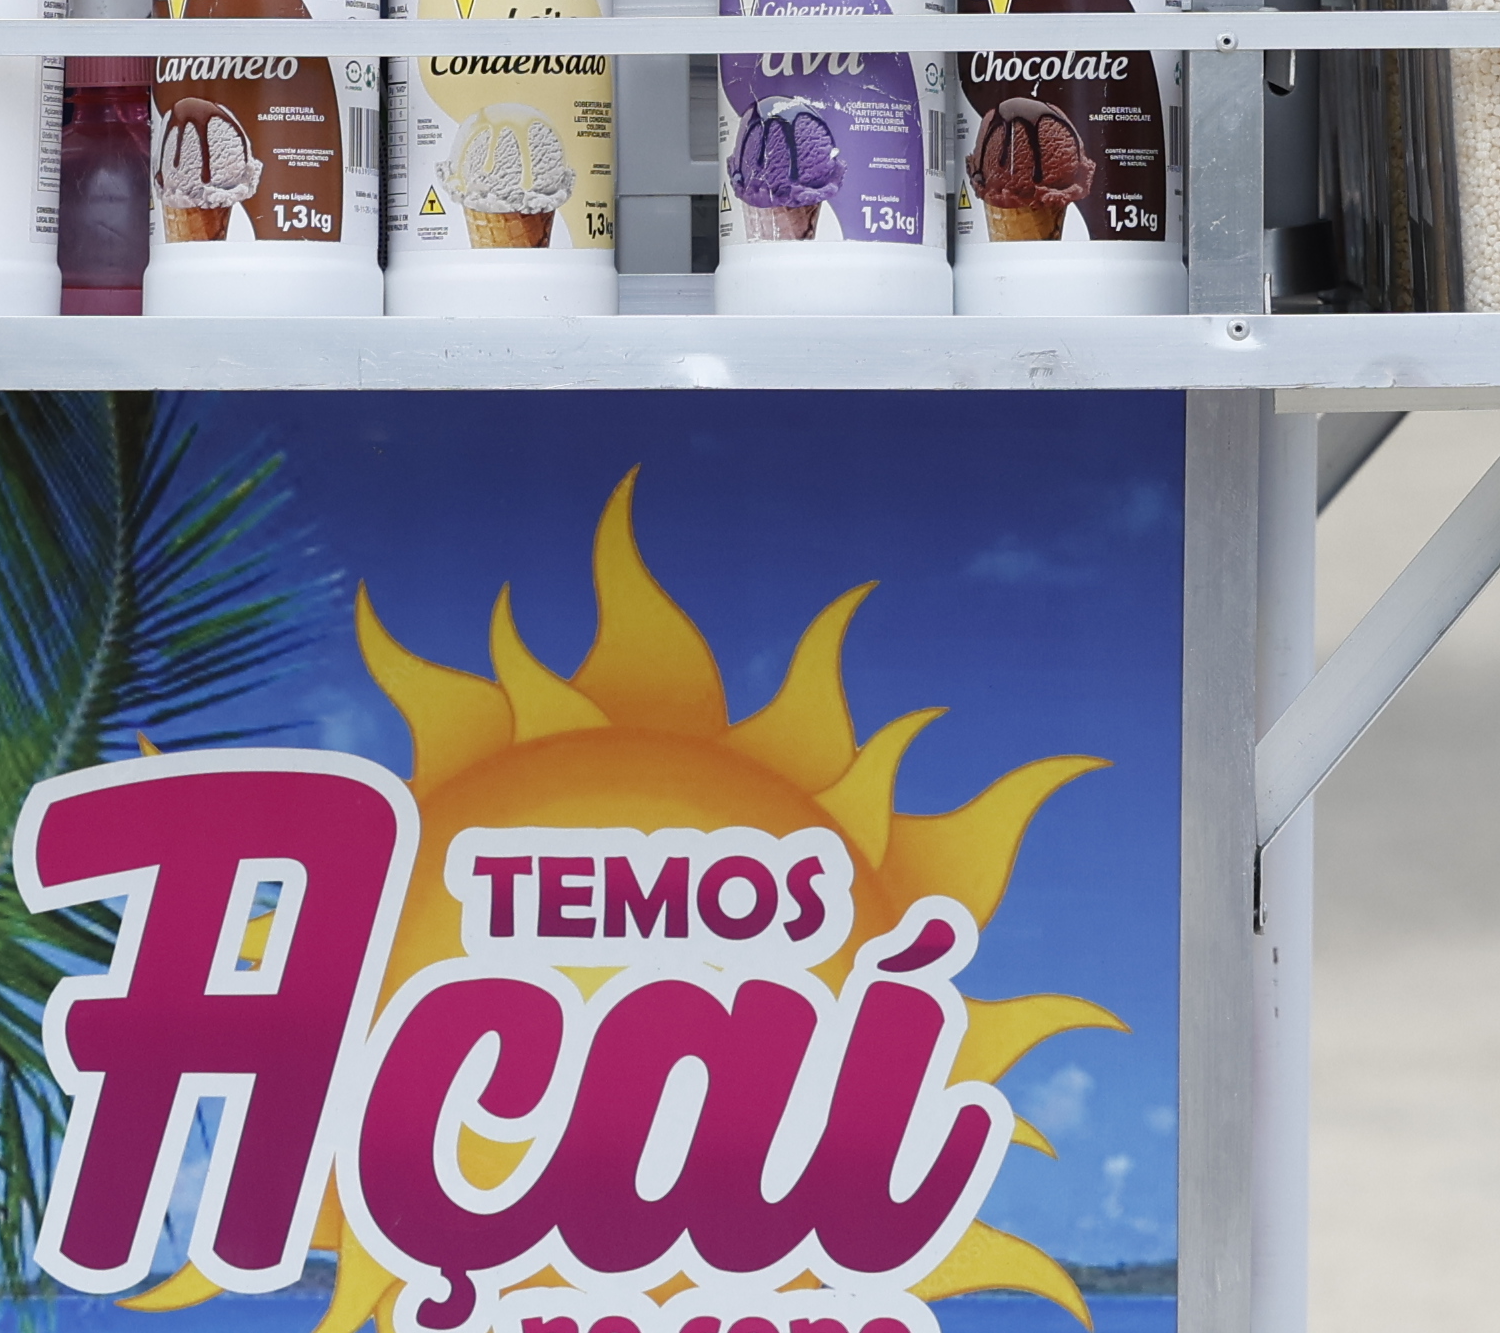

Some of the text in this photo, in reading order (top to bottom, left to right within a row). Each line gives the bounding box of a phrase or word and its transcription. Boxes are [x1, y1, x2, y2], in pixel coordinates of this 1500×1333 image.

[156, 56, 298, 84] Caramelo
[970, 51, 1129, 83] Chocolate
[269, 106, 314, 114] COBERTURA
[846, 101, 911, 111] COBERTURA SABOR
[257, 113, 325, 122] SABOR CARAMELO
[1115, 114, 1151, 122] CHOCOLATE
[849, 124, 909, 133] ARTIFICIALMENTE
[291, 193, 314, 201] Líquido
[861, 194, 900, 203] Peso Líquido
[1122, 193, 1143, 201] Líquido
[428, 200, 436, 211] T
[471, 854, 828, 941] TEMOS
[35, 770, 992, 1329] Açaí
